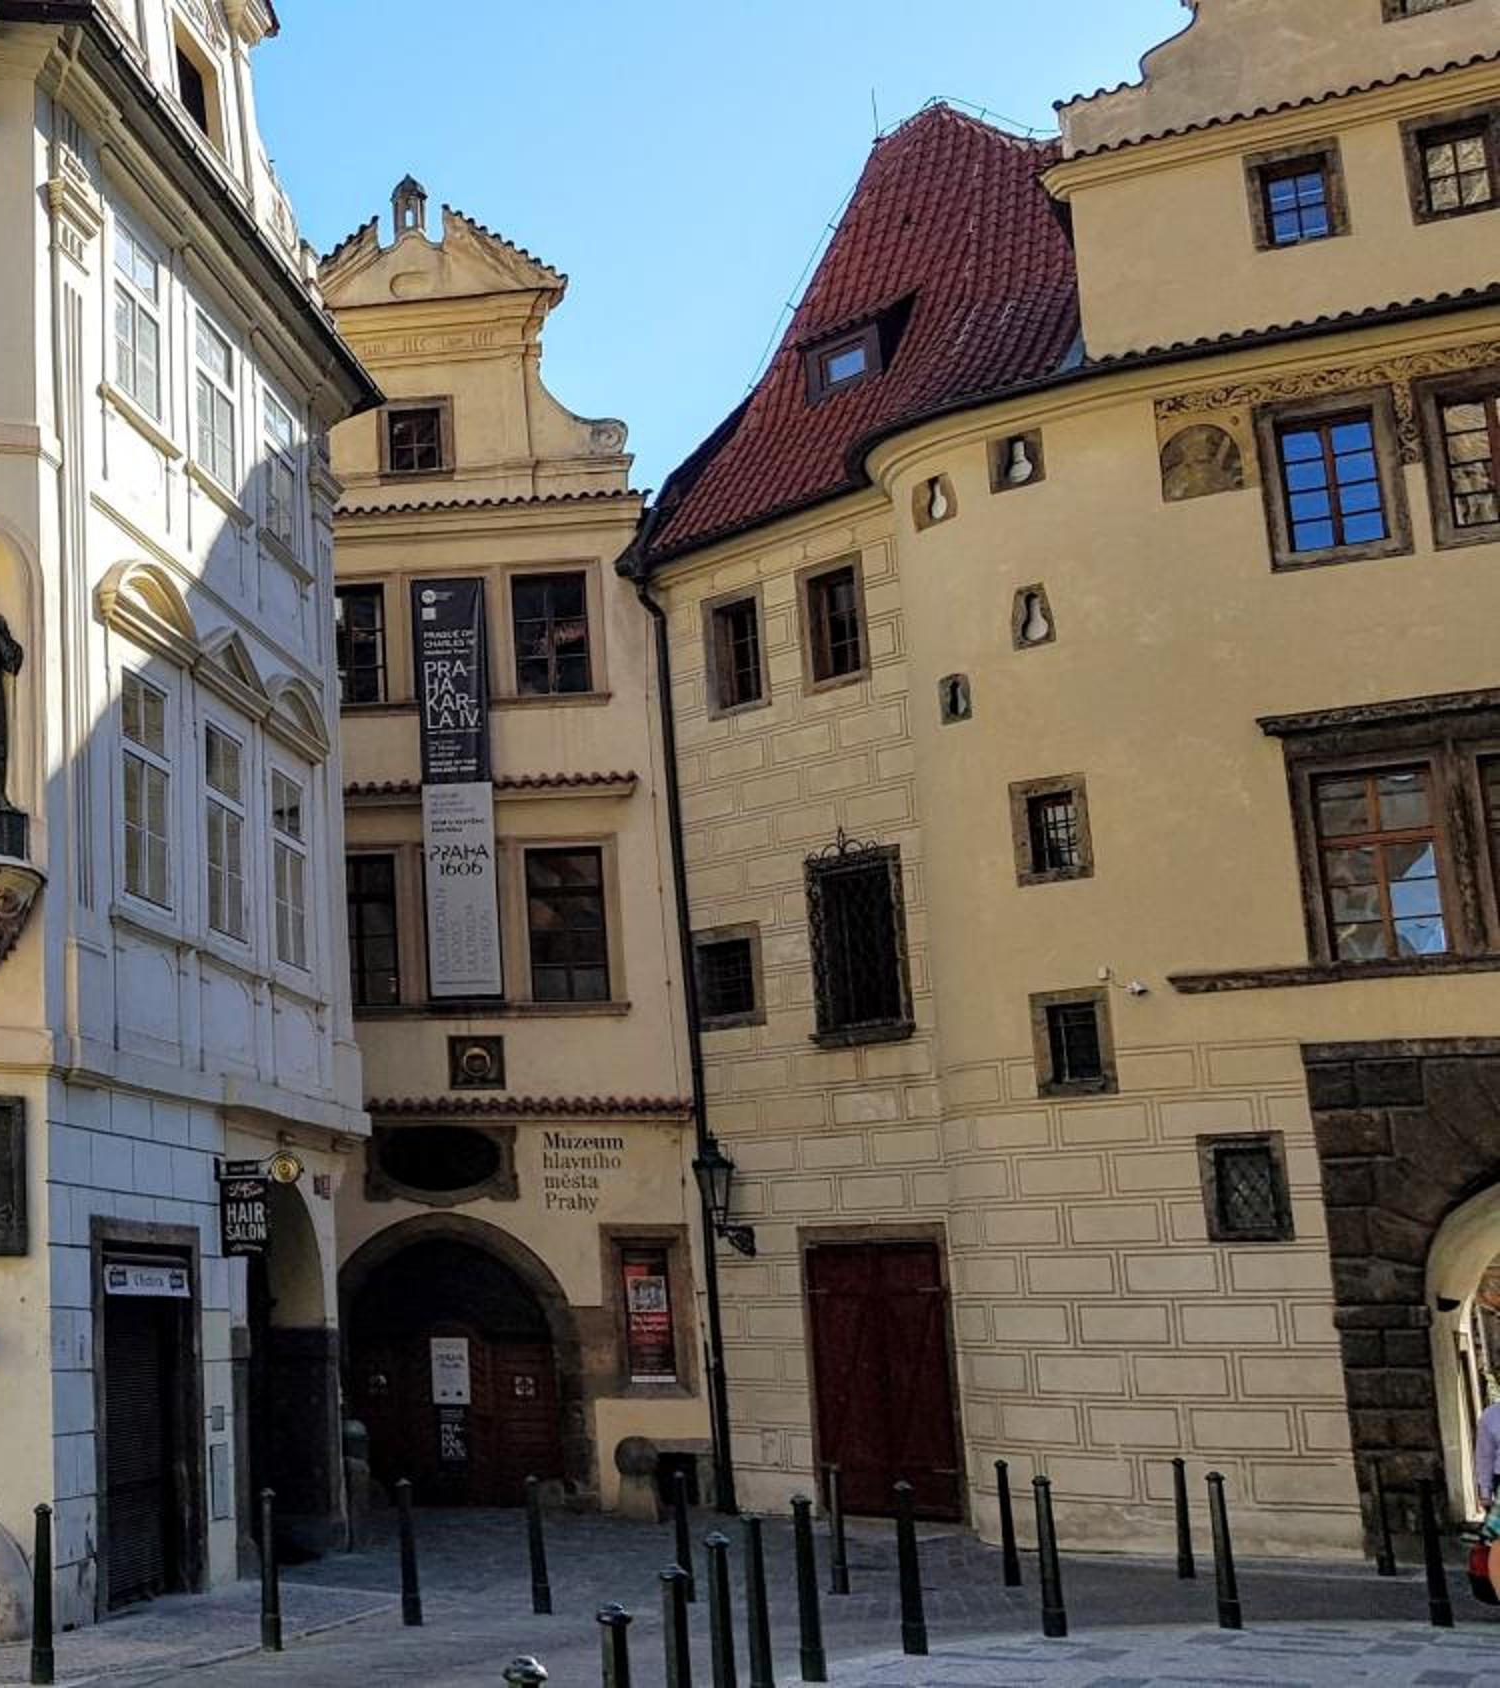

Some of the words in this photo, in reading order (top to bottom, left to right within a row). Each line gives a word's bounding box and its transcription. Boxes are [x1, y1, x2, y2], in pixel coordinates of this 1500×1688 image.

[423, 660, 477, 678] PRA-
[425, 677, 455, 696] HA
[426, 693, 477, 712] KAR-
[427, 709, 455, 729] LA
[429, 843, 490, 861] PRAHA
[439, 861, 483, 877] 1606
[543, 1131, 624, 1150] Muzeum
[543, 1151, 621, 1169] hlavního
[545, 1172, 599, 1189] města
[545, 1191, 599, 1214] Prahy
[226, 1201, 266, 1223] HAIR
[225, 1223, 268, 1241] SALON
